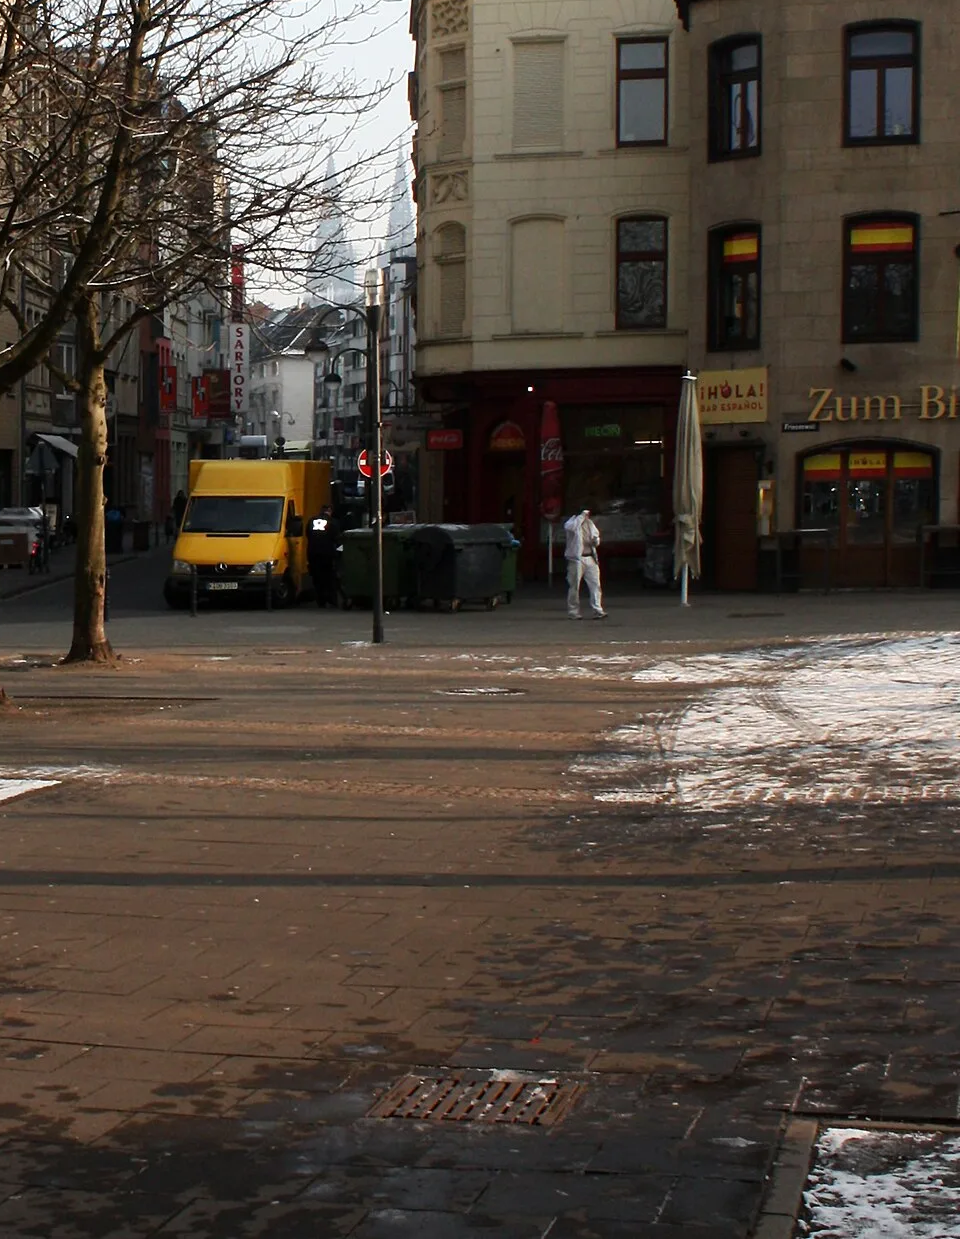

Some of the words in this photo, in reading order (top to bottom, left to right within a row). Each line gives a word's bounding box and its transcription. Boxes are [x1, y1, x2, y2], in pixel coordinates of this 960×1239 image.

[233, 327, 245, 409] SARTORY
[699, 403, 717, 413] BAR
[720, 400, 763, 412] ESPAÑOL
[807, 387, 904, 422] Zum
[918, 384, 959, 421] Bi
